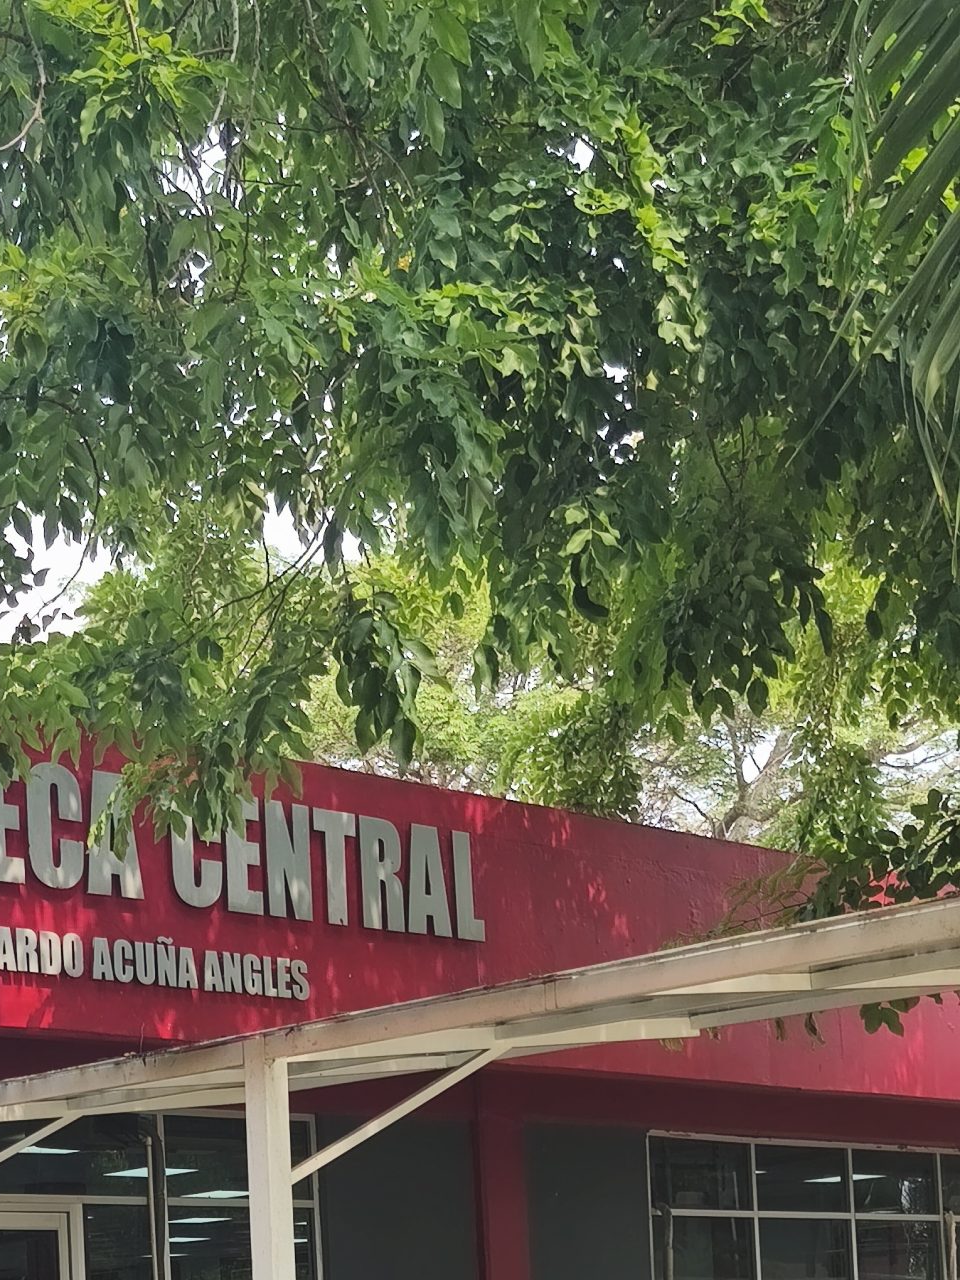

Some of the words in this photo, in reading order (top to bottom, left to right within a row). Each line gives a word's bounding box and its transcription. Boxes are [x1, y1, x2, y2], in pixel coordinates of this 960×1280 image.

[171, 795, 486, 943] CENTRAL
[92, 935, 199, 990] ACUÑA
[203, 949, 311, 1001] ANGLES
